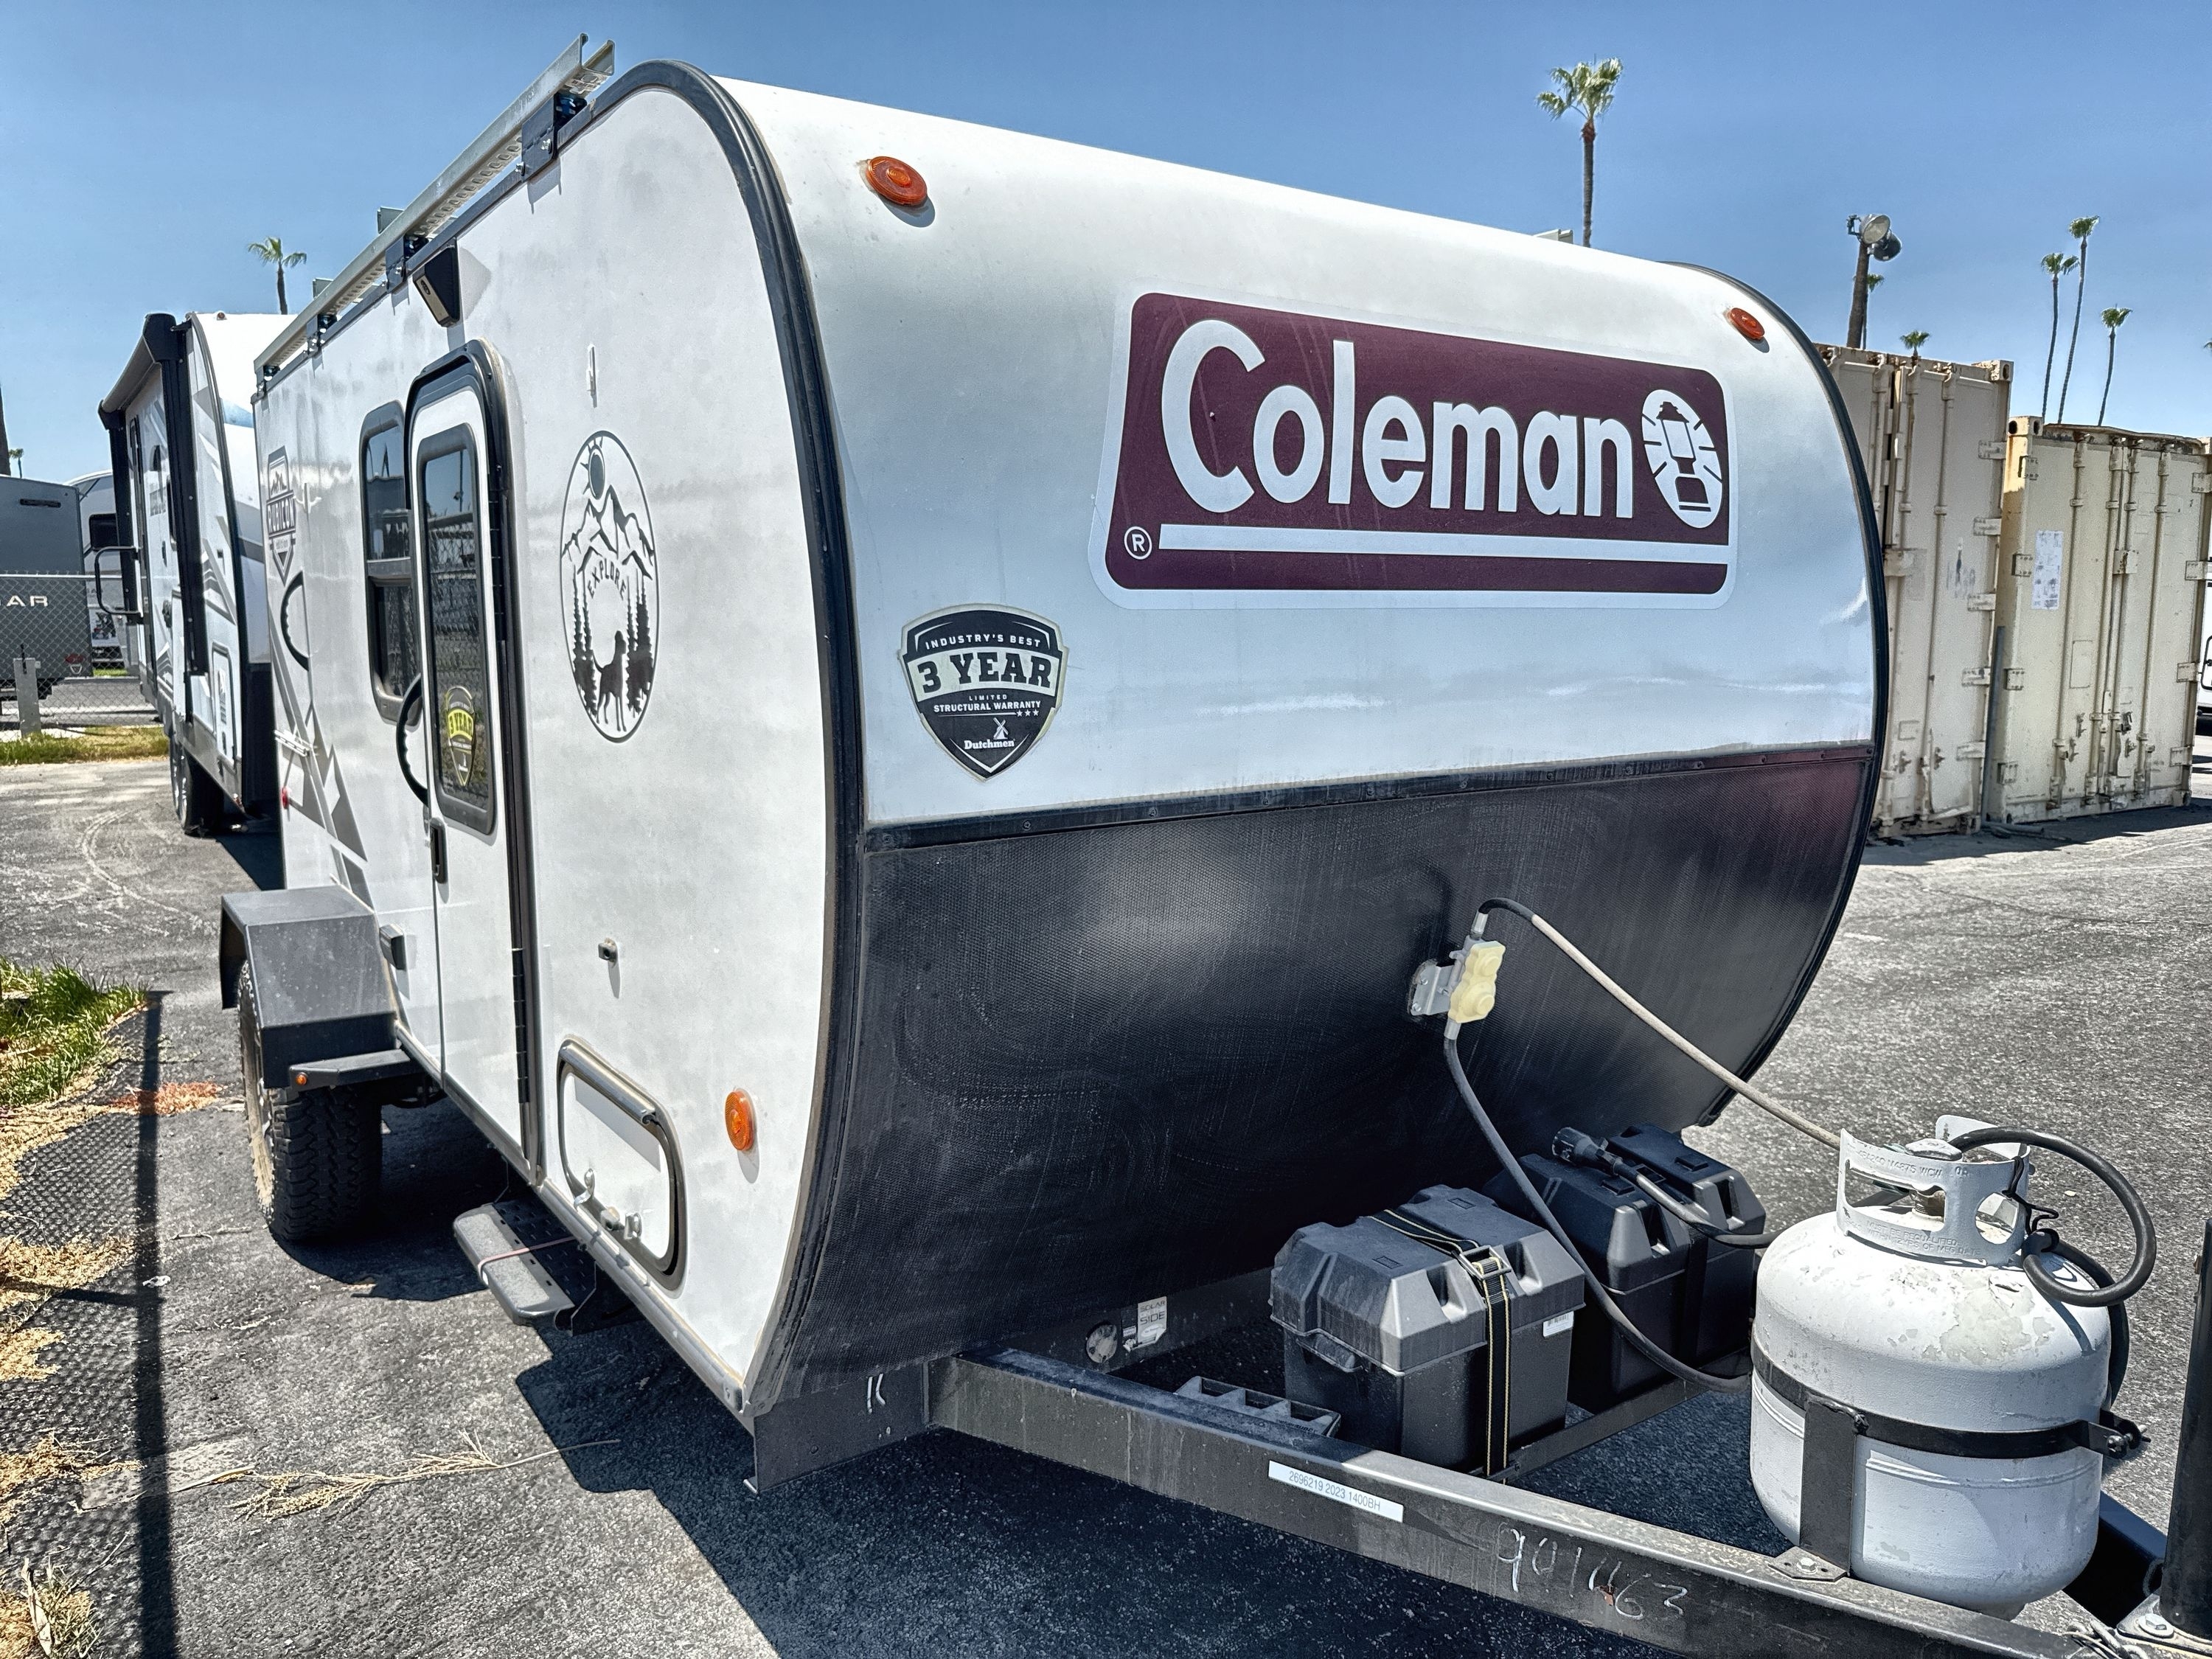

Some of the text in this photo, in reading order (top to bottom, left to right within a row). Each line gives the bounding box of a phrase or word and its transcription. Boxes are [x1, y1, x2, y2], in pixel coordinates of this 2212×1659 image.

[1161, 319, 1632, 518] Coleman
[587, 557, 627, 601] EXPLORE
[0, 595, 49, 607] AR
[925, 633, 1041, 650] INDUSTRY'S BEST
[917, 651, 1052, 693] 3 YEAR
[933, 700, 1041, 713] STRUCTURAL WARRANTY
[449, 712, 472, 737] 3 YEAR
[964, 739, 1015, 750] Dutchmen
[1140, 1300, 1165, 1312] SOLAR
[1140, 1310, 1166, 1325] SIDE
[1289, 1470, 1381, 1512] 2696219 2023 1400BH
